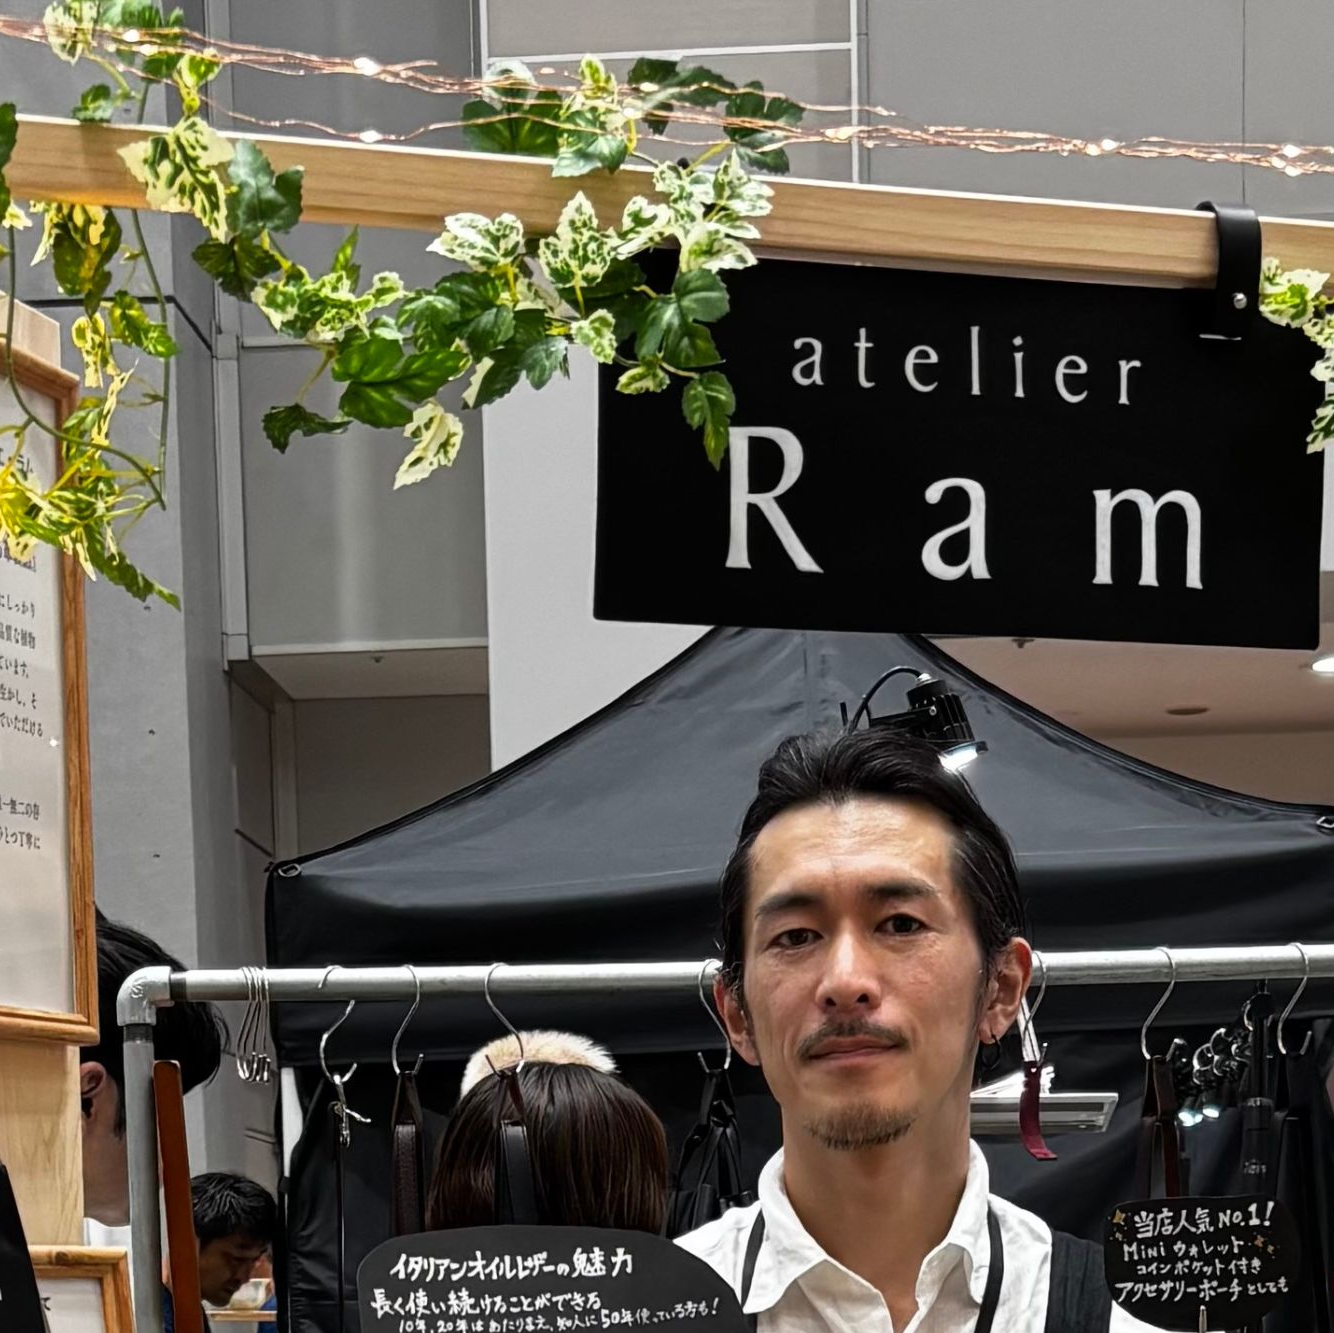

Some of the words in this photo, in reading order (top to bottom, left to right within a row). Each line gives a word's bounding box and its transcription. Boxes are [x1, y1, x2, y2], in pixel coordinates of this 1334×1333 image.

[792, 326, 1141, 405] atelier
[724, 426, 1204, 590] Ram
[1134, 1207, 1214, 1239] 当店人気
[1173, 1236, 1244, 1258] ウォレット
[389, 1247, 633, 1282] イタリアンオイルレザーの魅力
[1136, 1257, 1262, 1276] コインポケット付き
[370, 1287, 601, 1319] 長く使い続けることができる
[1115, 1276, 1289, 1302] アクセサリーポーチとしても
